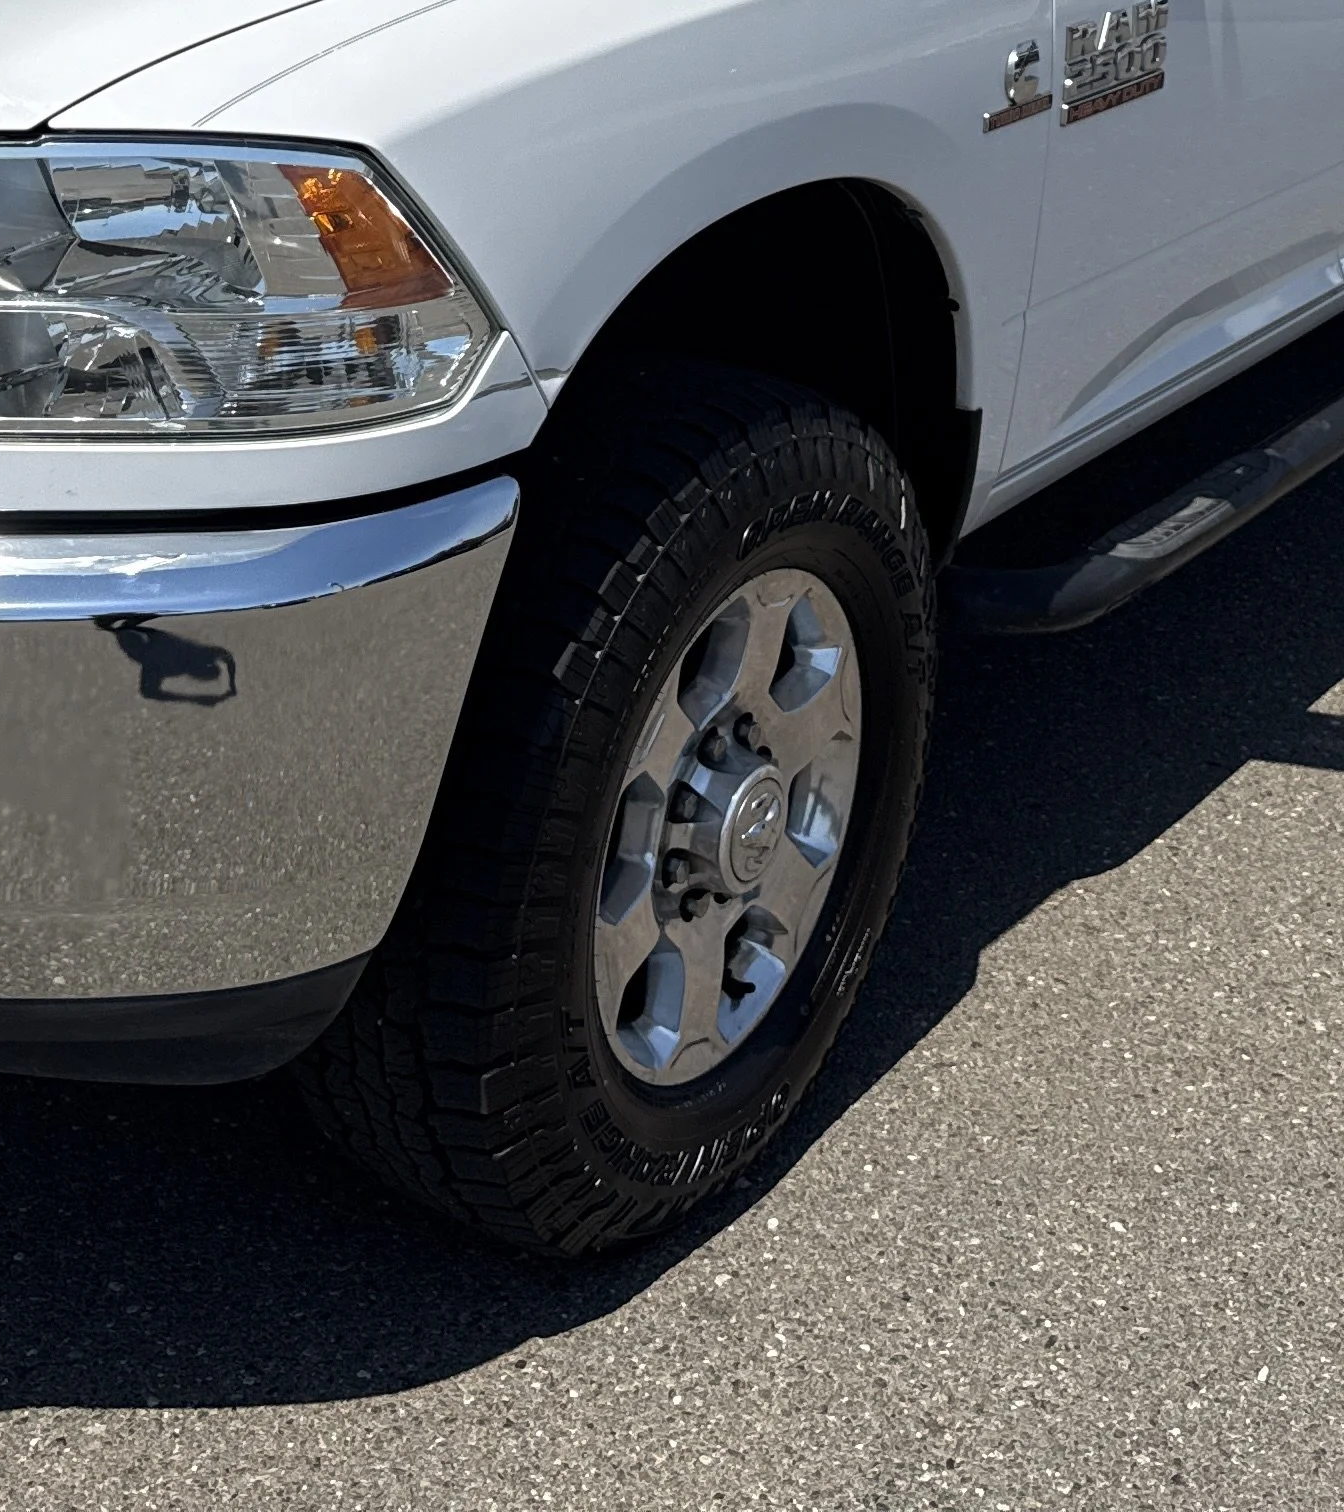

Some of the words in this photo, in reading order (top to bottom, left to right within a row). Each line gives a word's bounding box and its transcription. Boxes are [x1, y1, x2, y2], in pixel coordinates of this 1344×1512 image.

[1069, 90, 1122, 122] HEAVY
[1122, 75, 1162, 99] DUTY
[736, 488, 836, 561] OPEN
[830, 493, 915, 600] RANGE
